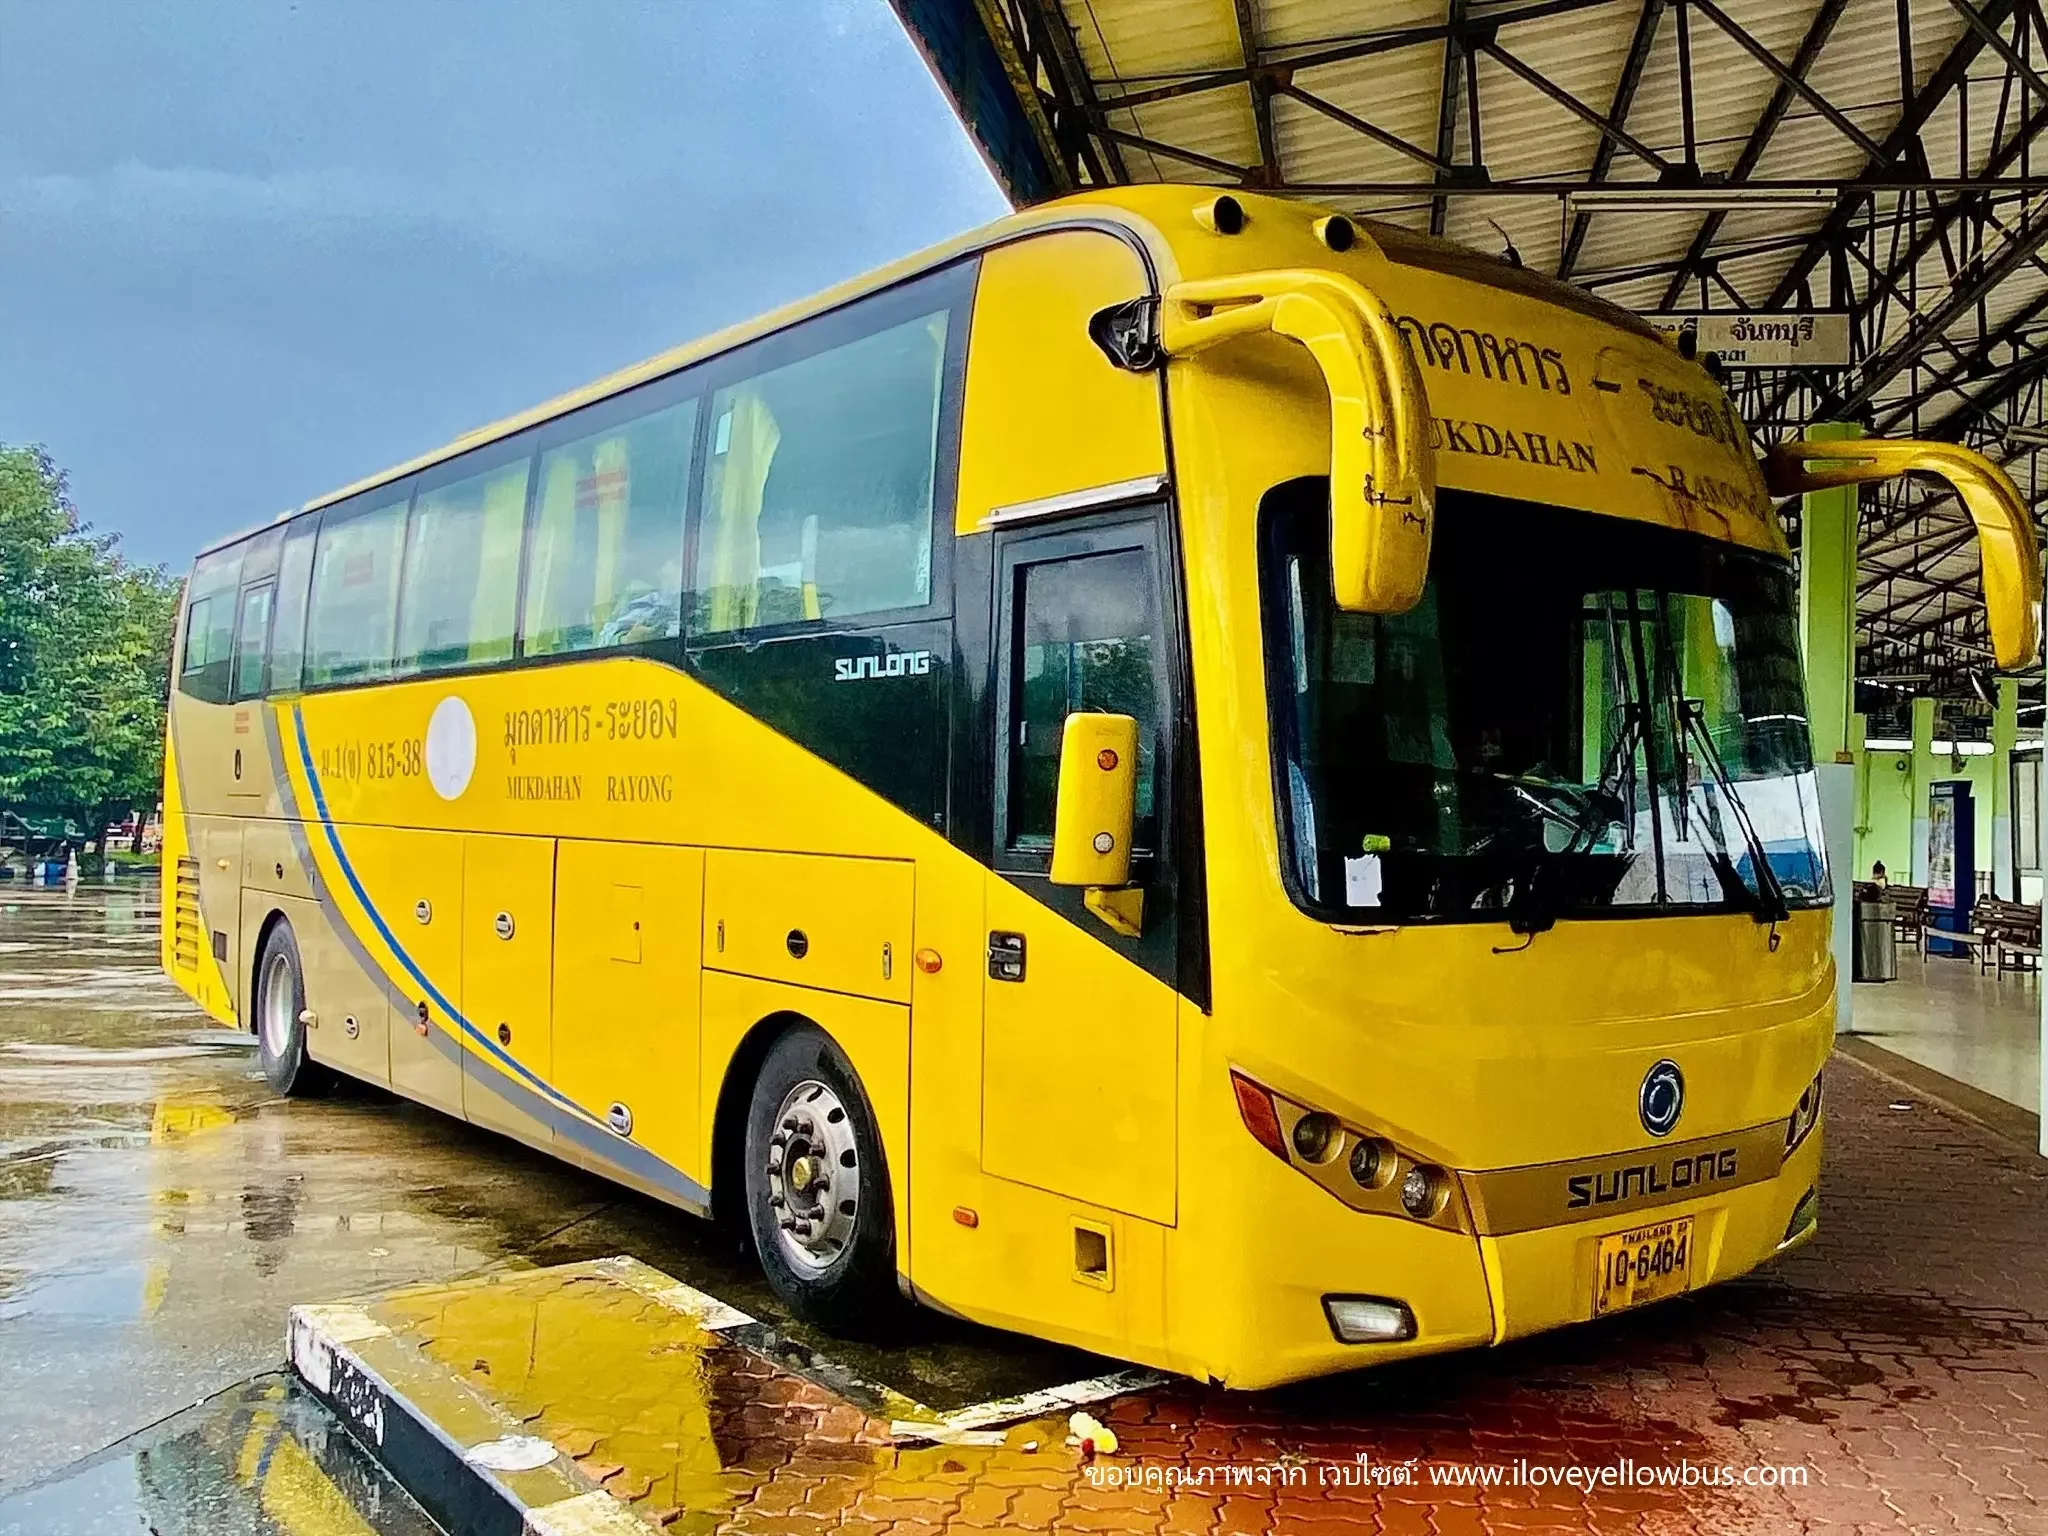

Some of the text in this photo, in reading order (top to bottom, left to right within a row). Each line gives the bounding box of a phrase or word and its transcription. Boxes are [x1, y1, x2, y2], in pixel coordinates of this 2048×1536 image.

[1396, 316, 1571, 396] กดาหาร
[1732, 316, 1814, 347] จันทบุรี
[1427, 416, 1598, 473] UKDAHAN
[835, 650, 930, 681] SUNLONG
[367, 738, 421, 779] 815-38
[506, 774, 673, 803] MUKDAHAN RAYONG
[1567, 1148, 1738, 1209] SUNLONG
[1605, 1234, 1687, 1291] 10-6464
